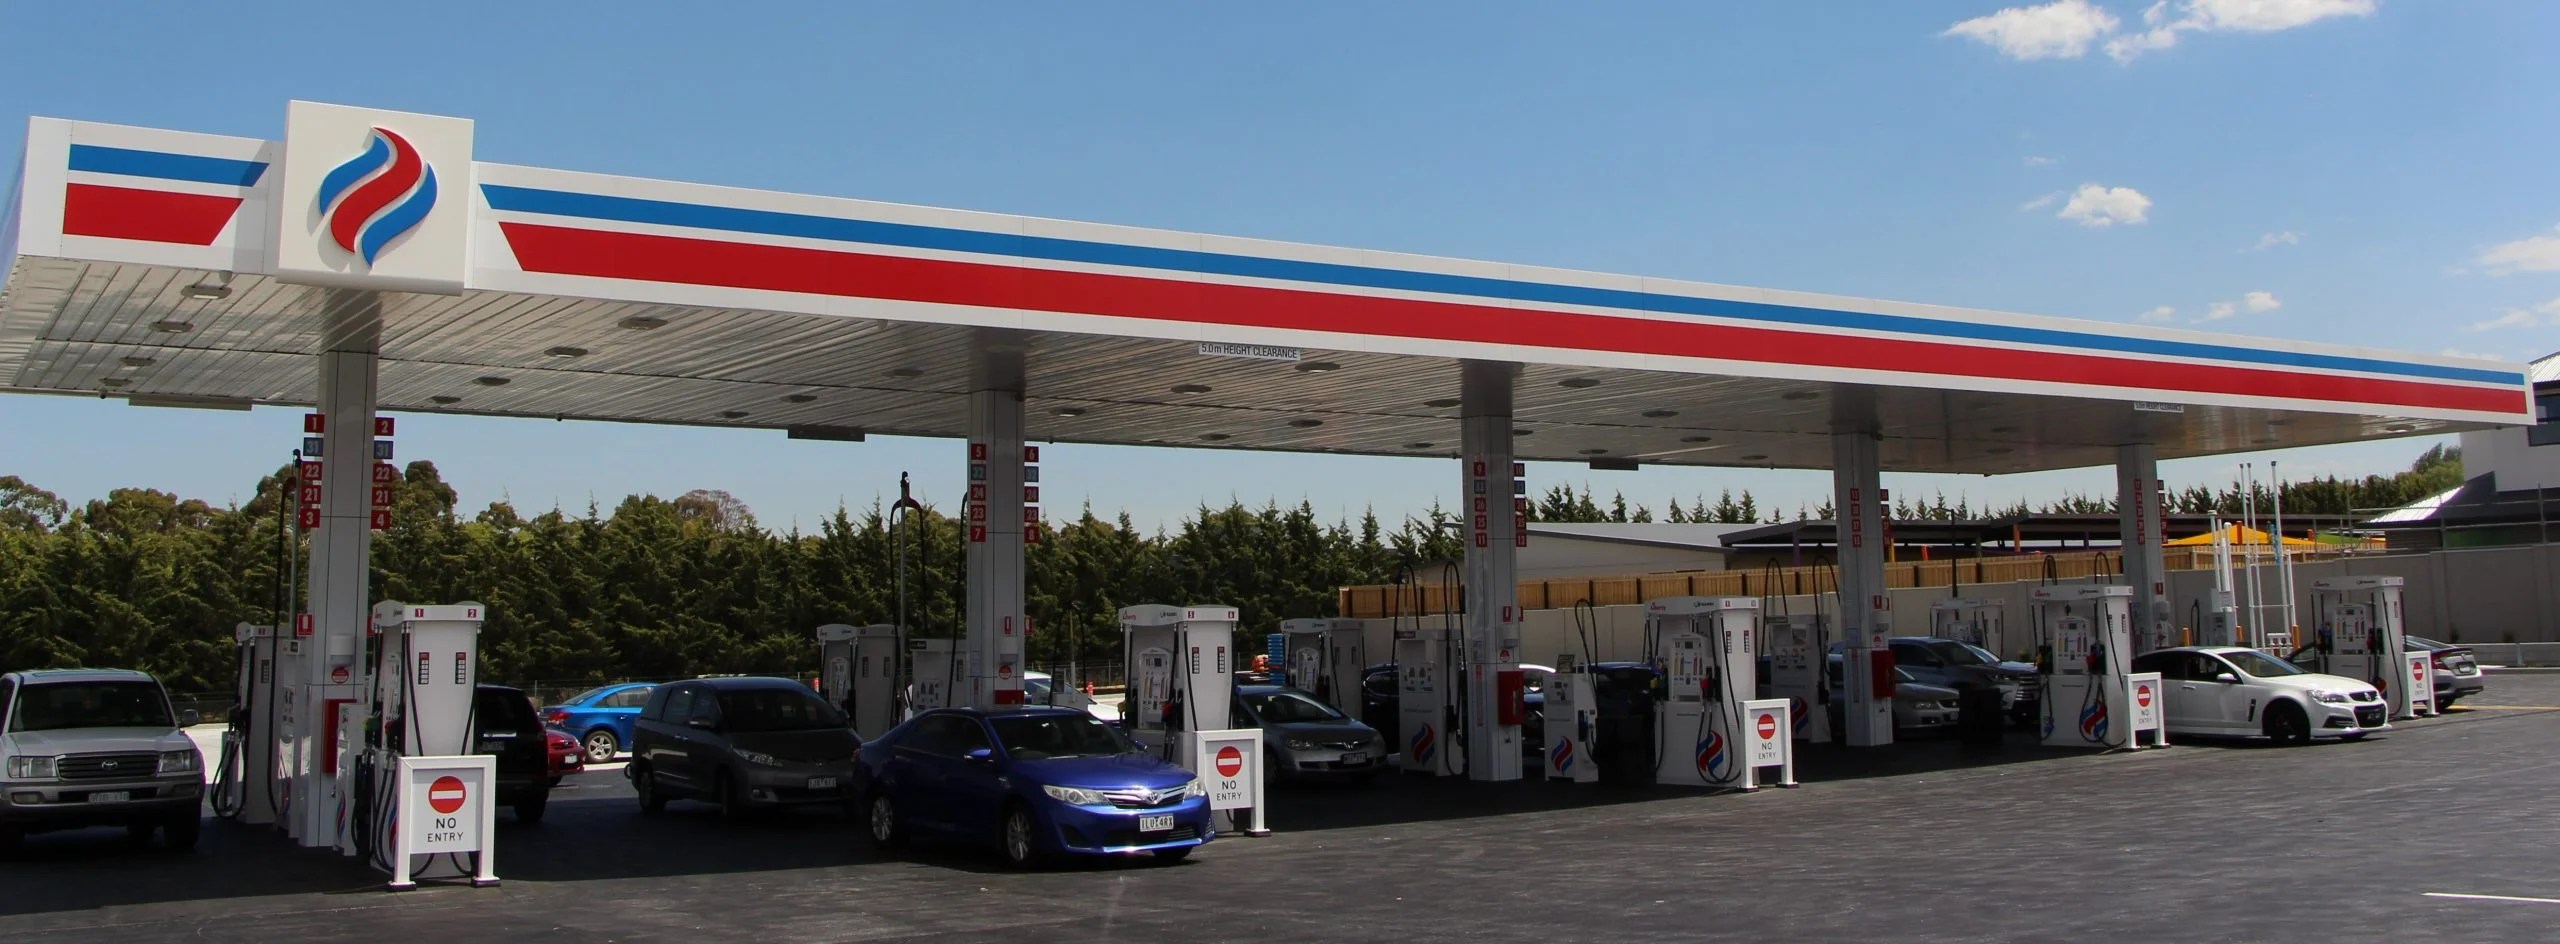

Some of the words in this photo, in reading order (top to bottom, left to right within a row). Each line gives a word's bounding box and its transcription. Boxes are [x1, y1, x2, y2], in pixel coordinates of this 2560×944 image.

[1201, 343, 1221, 354] 5.0m
[1223, 344, 1251, 355] HEIGHT
[1253, 346, 1297, 358] CLEARANCE
[381, 420, 389, 434] 2
[306, 440, 319, 454] 31
[376, 443, 389, 457] 31
[976, 446, 982, 458] 5
[304, 464, 319, 478] 22
[375, 466, 390, 480] 22
[304, 487, 319, 502] 21
[375, 490, 389, 504] 21
[305, 511, 314, 525] 3
[376, 513, 385, 527] 4
[1761, 742, 1772, 750] NO
[1758, 752, 1776, 760] ENTRY
[1221, 780, 1237, 790] NO
[1216, 792, 1242, 801] ENTRY
[435, 817, 457, 829] NO
[427, 831, 464, 843] ENTRY
